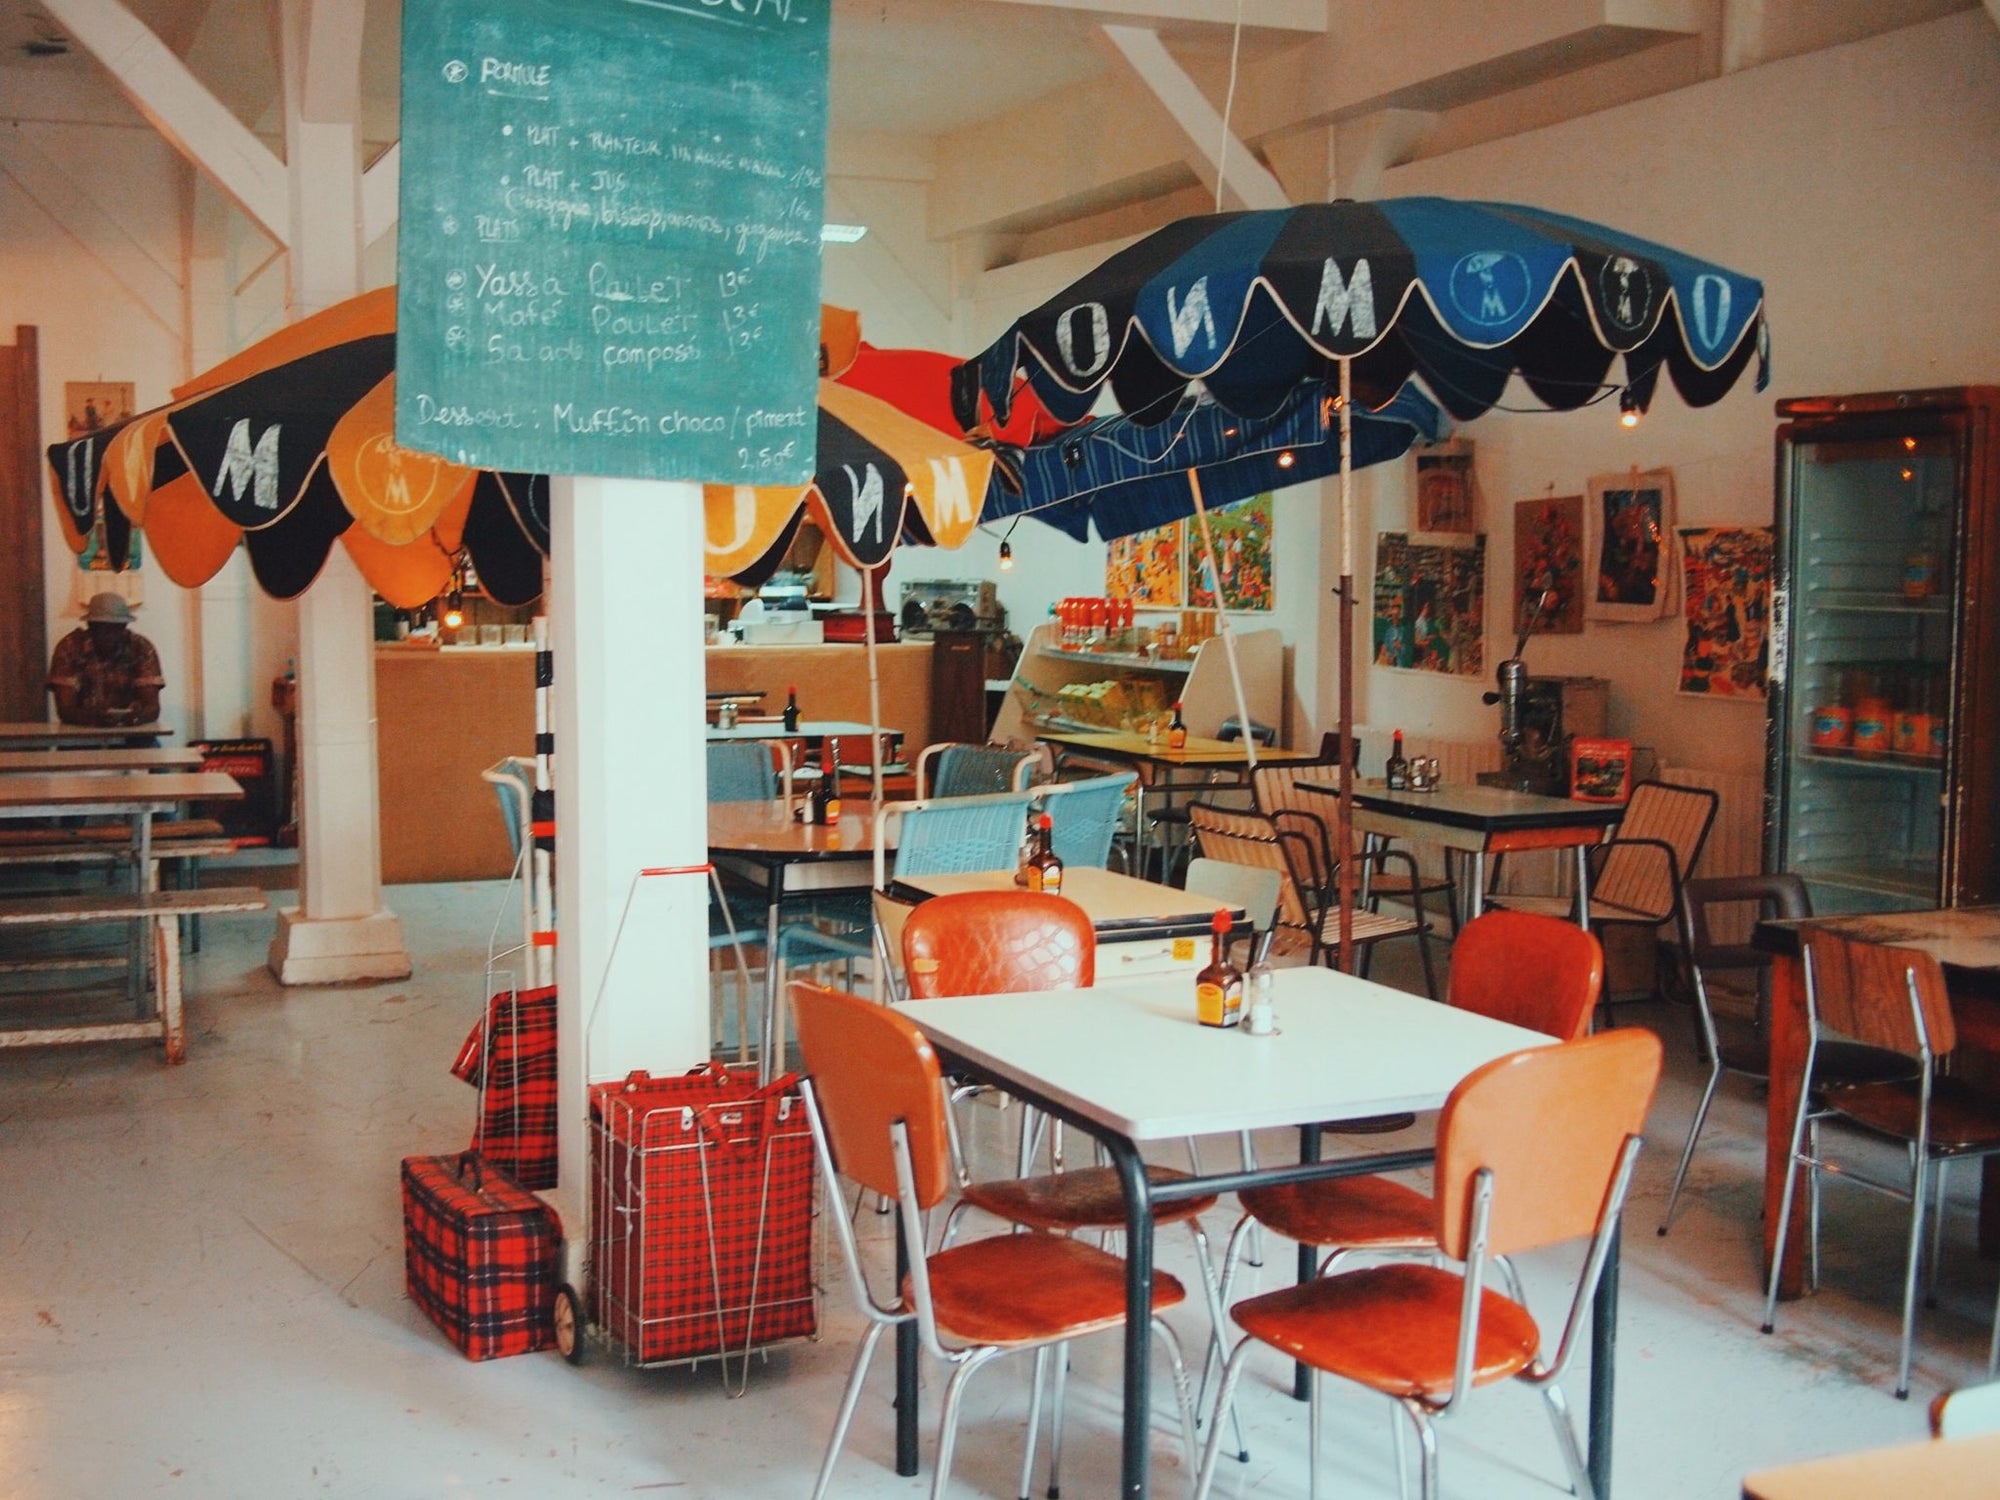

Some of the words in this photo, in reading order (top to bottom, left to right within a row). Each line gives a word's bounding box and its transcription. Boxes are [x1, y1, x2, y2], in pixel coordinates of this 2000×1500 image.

[522, 164, 564, 191] PLAT
[590, 169, 627, 193] JUS
[474, 262, 570, 298] Yassa
[553, 401, 650, 437] Muffin
[658, 409, 726, 435] choco
